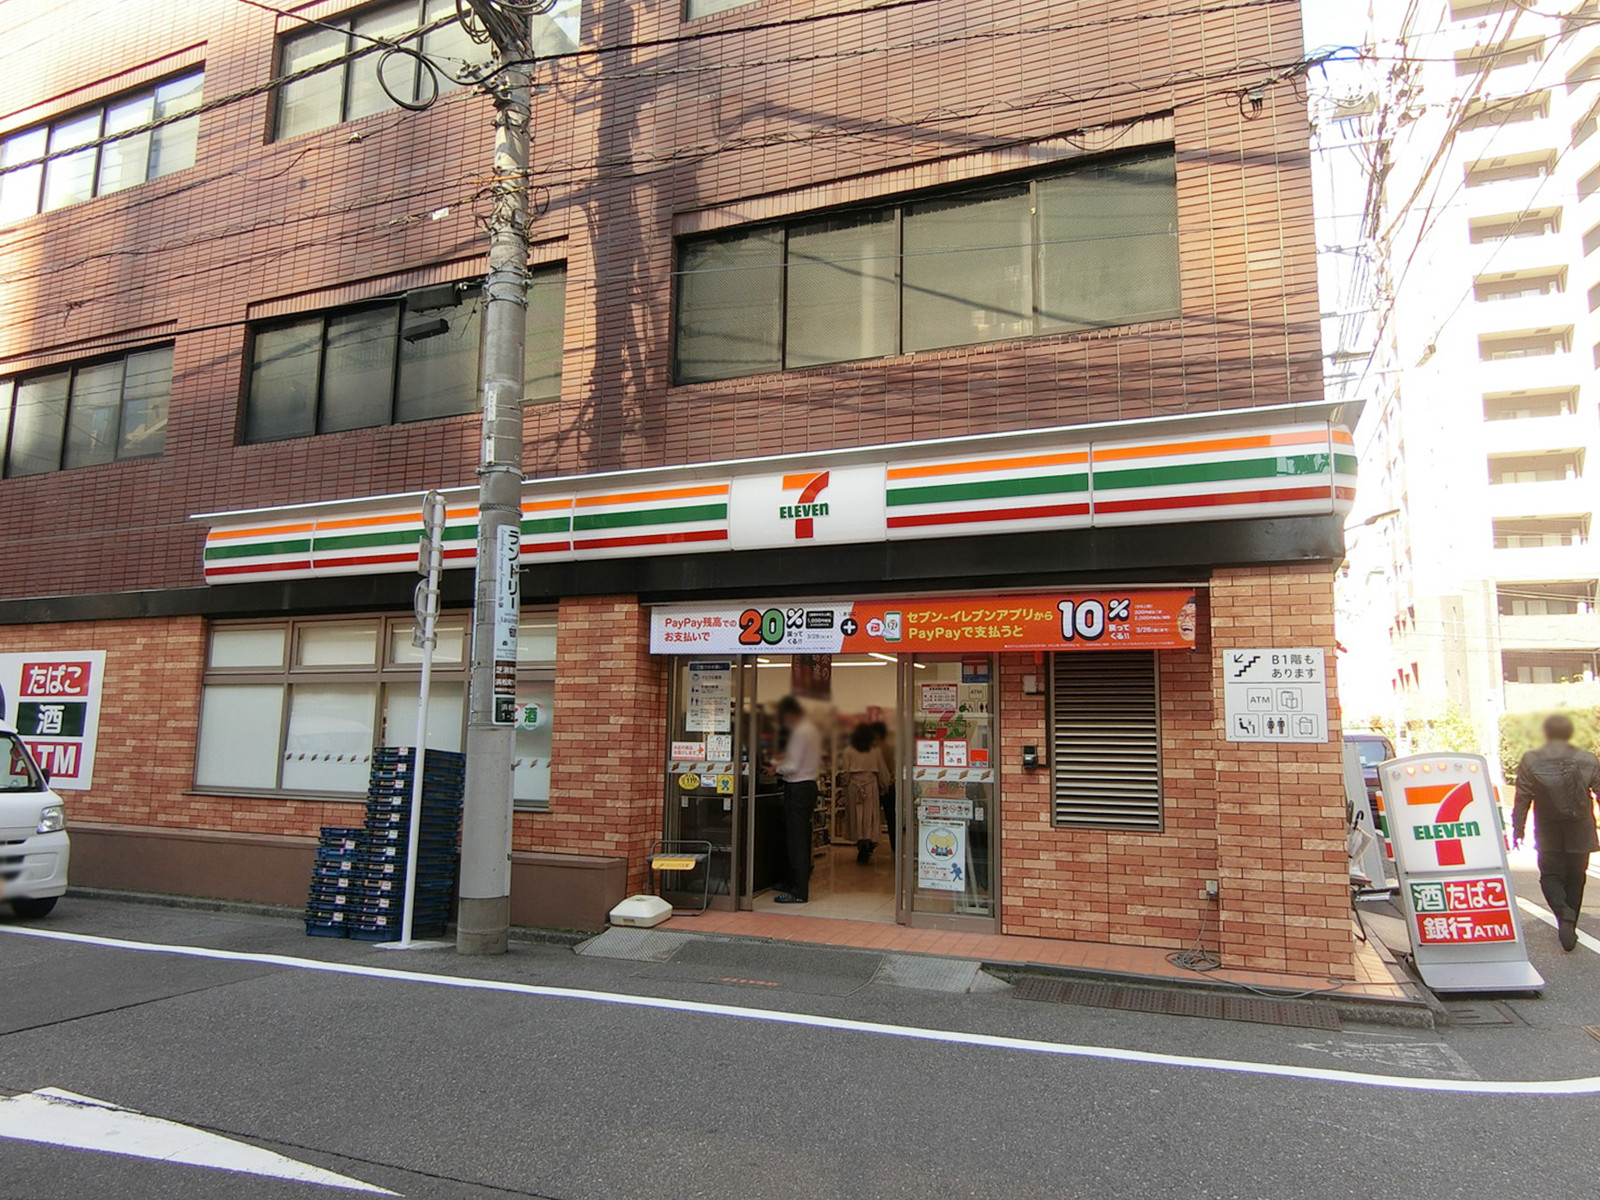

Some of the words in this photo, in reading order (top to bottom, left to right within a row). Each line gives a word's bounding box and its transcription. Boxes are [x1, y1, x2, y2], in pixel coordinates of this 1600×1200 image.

[508, 530, 519, 609] ランドリー
[664, 616, 738, 630] PayPay残高での
[1108, 624, 1130, 632] 戻って
[664, 631, 711, 642] お支払いで
[908, 625, 1024, 642] PayPayで支払うと
[1271, 654, 1315, 665] B1階も
[27, 664, 82, 694] たばこ
[1271, 668, 1316, 679] あります
[1250, 696, 1270, 704] ATM
[36, 704, 65, 735] 酒
[524, 707, 538, 723] 酒
[1414, 884, 1446, 911] 酒
[1446, 881, 1507, 909] たばこ
